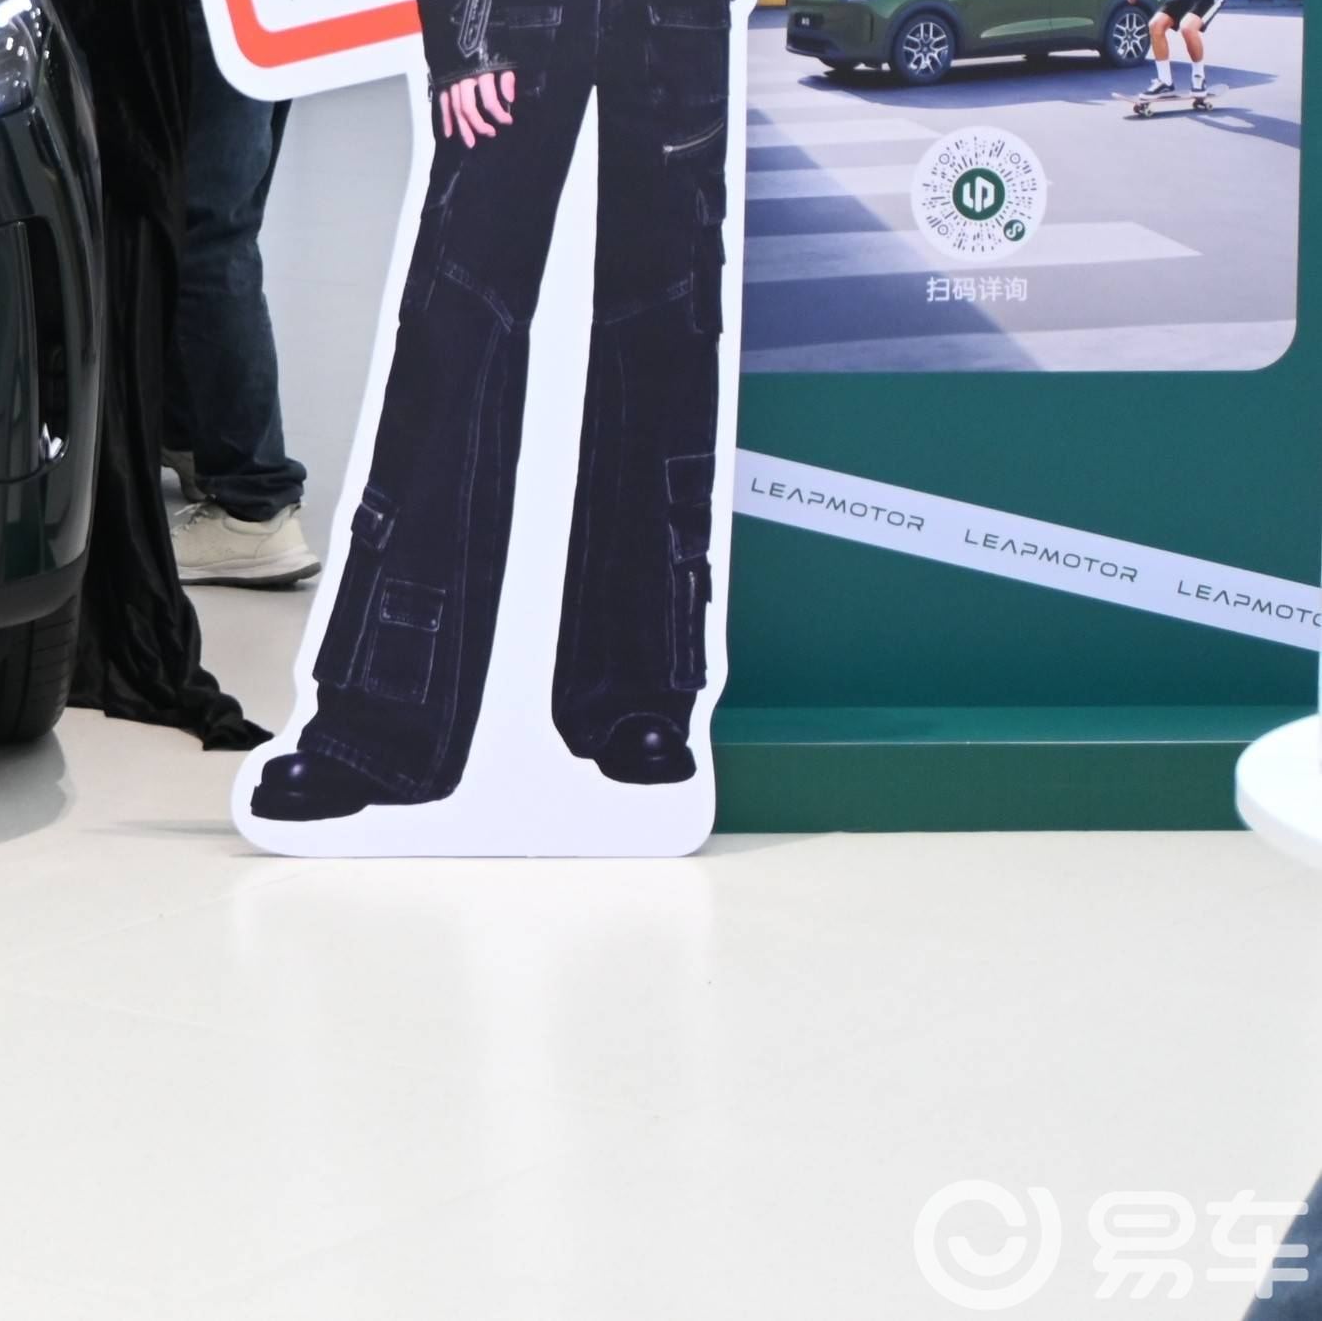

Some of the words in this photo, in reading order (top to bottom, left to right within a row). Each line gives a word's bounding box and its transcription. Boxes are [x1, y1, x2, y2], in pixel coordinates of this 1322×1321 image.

[925, 276, 1028, 303] 扫码详询
[750, 477, 926, 533] LEAPMOTOR
[964, 528, 1139, 583] LEAPMOTOR
